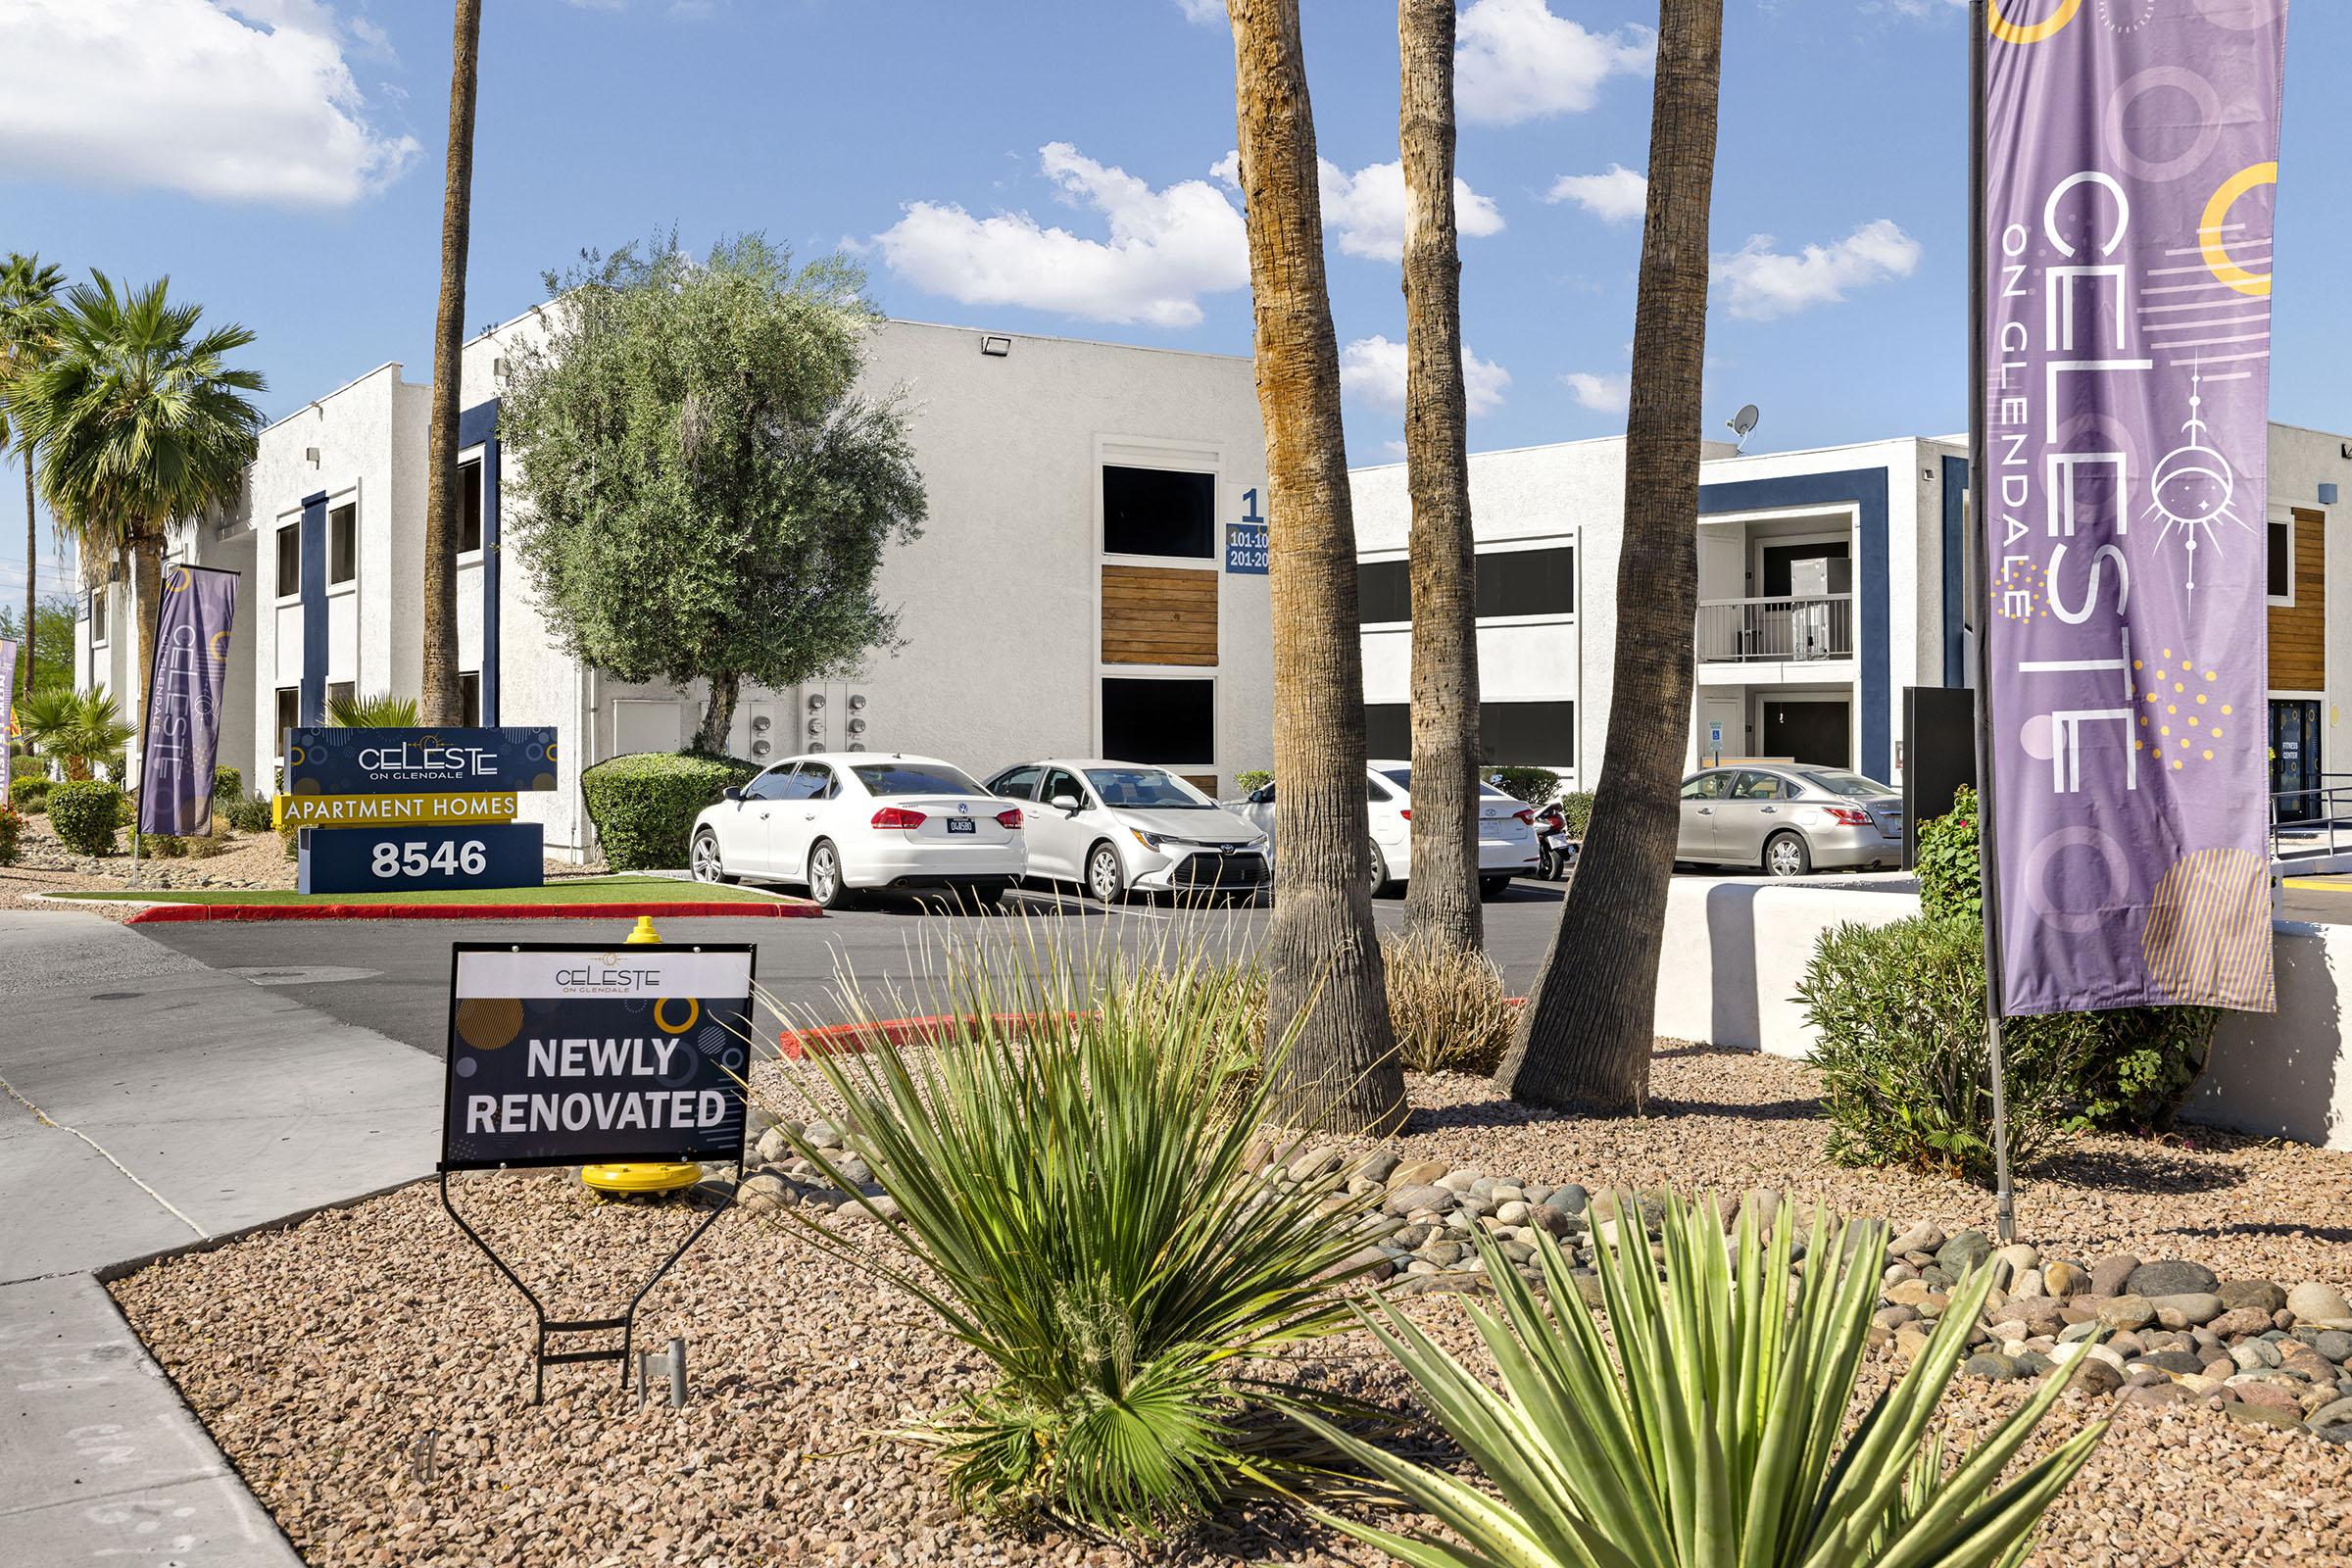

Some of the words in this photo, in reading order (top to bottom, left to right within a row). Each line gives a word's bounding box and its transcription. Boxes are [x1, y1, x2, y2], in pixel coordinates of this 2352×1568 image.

[2001, 222, 2028, 298] ON
[2000, 321, 2031, 618] GLENDALE
[2019, 171, 2153, 794] CELESTE
[1242, 488, 1264, 523] 1
[160, 634, 171, 654] ON
[151, 659, 166, 734] GLENDALE
[153, 624, 198, 781] CELESTE
[358, 741, 498, 775] CELESTE
[393, 771, 464, 780] GLENDALE
[284, 799, 423, 820] APARTMENT
[433, 796, 515, 816] HOMES
[371, 840, 487, 879] 8546
[555, 964, 661, 991] CELESTE
[526, 1038, 681, 1078] NEWLY
[466, 1090, 726, 1134] RENOVATED
